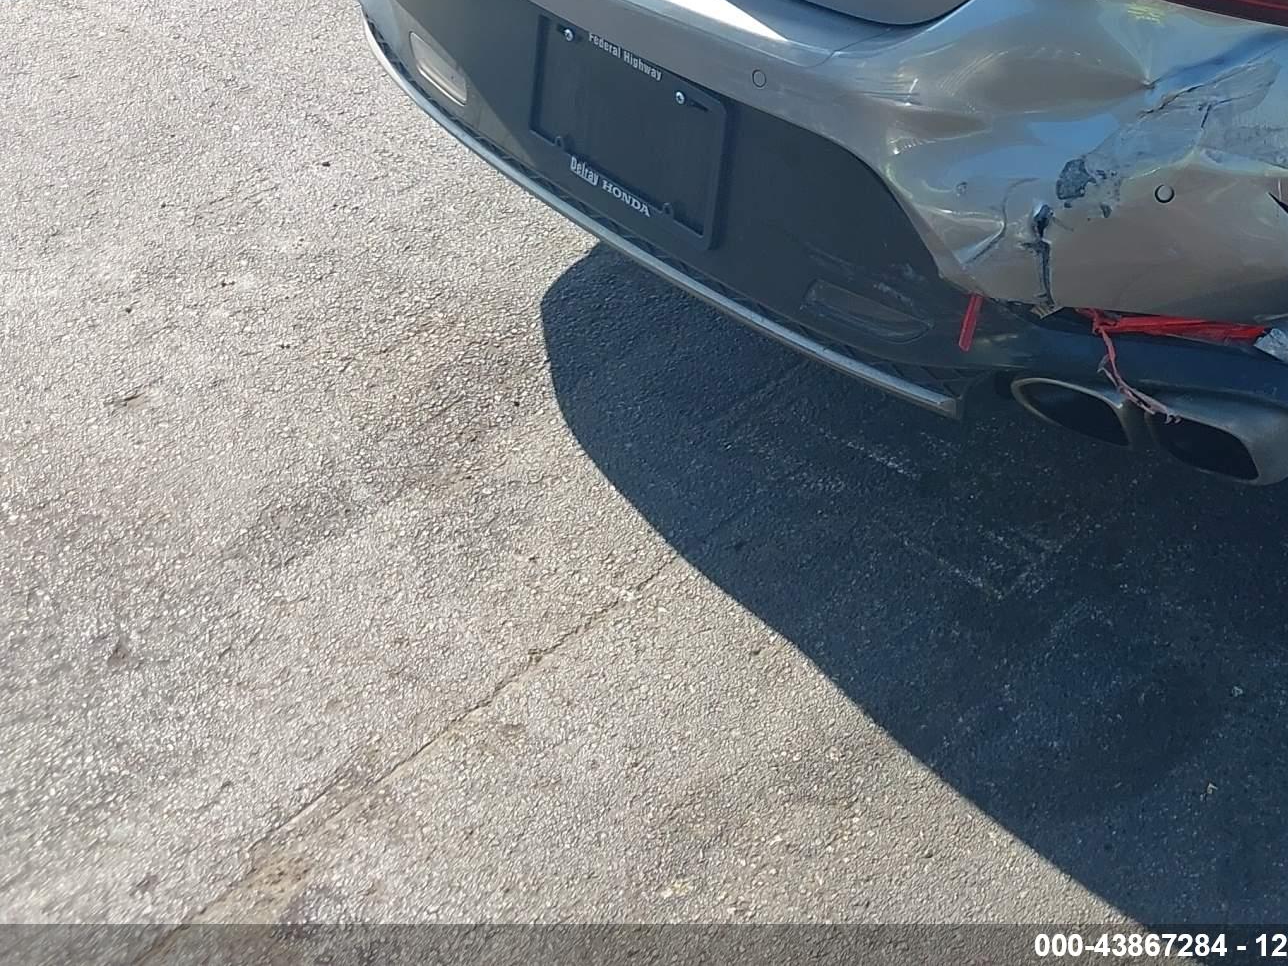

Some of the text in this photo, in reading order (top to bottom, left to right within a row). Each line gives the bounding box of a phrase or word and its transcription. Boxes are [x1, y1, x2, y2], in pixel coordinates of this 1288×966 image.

[588, 33, 662, 81] Federal Highway
[570, 155, 651, 218] Delray HONDA
